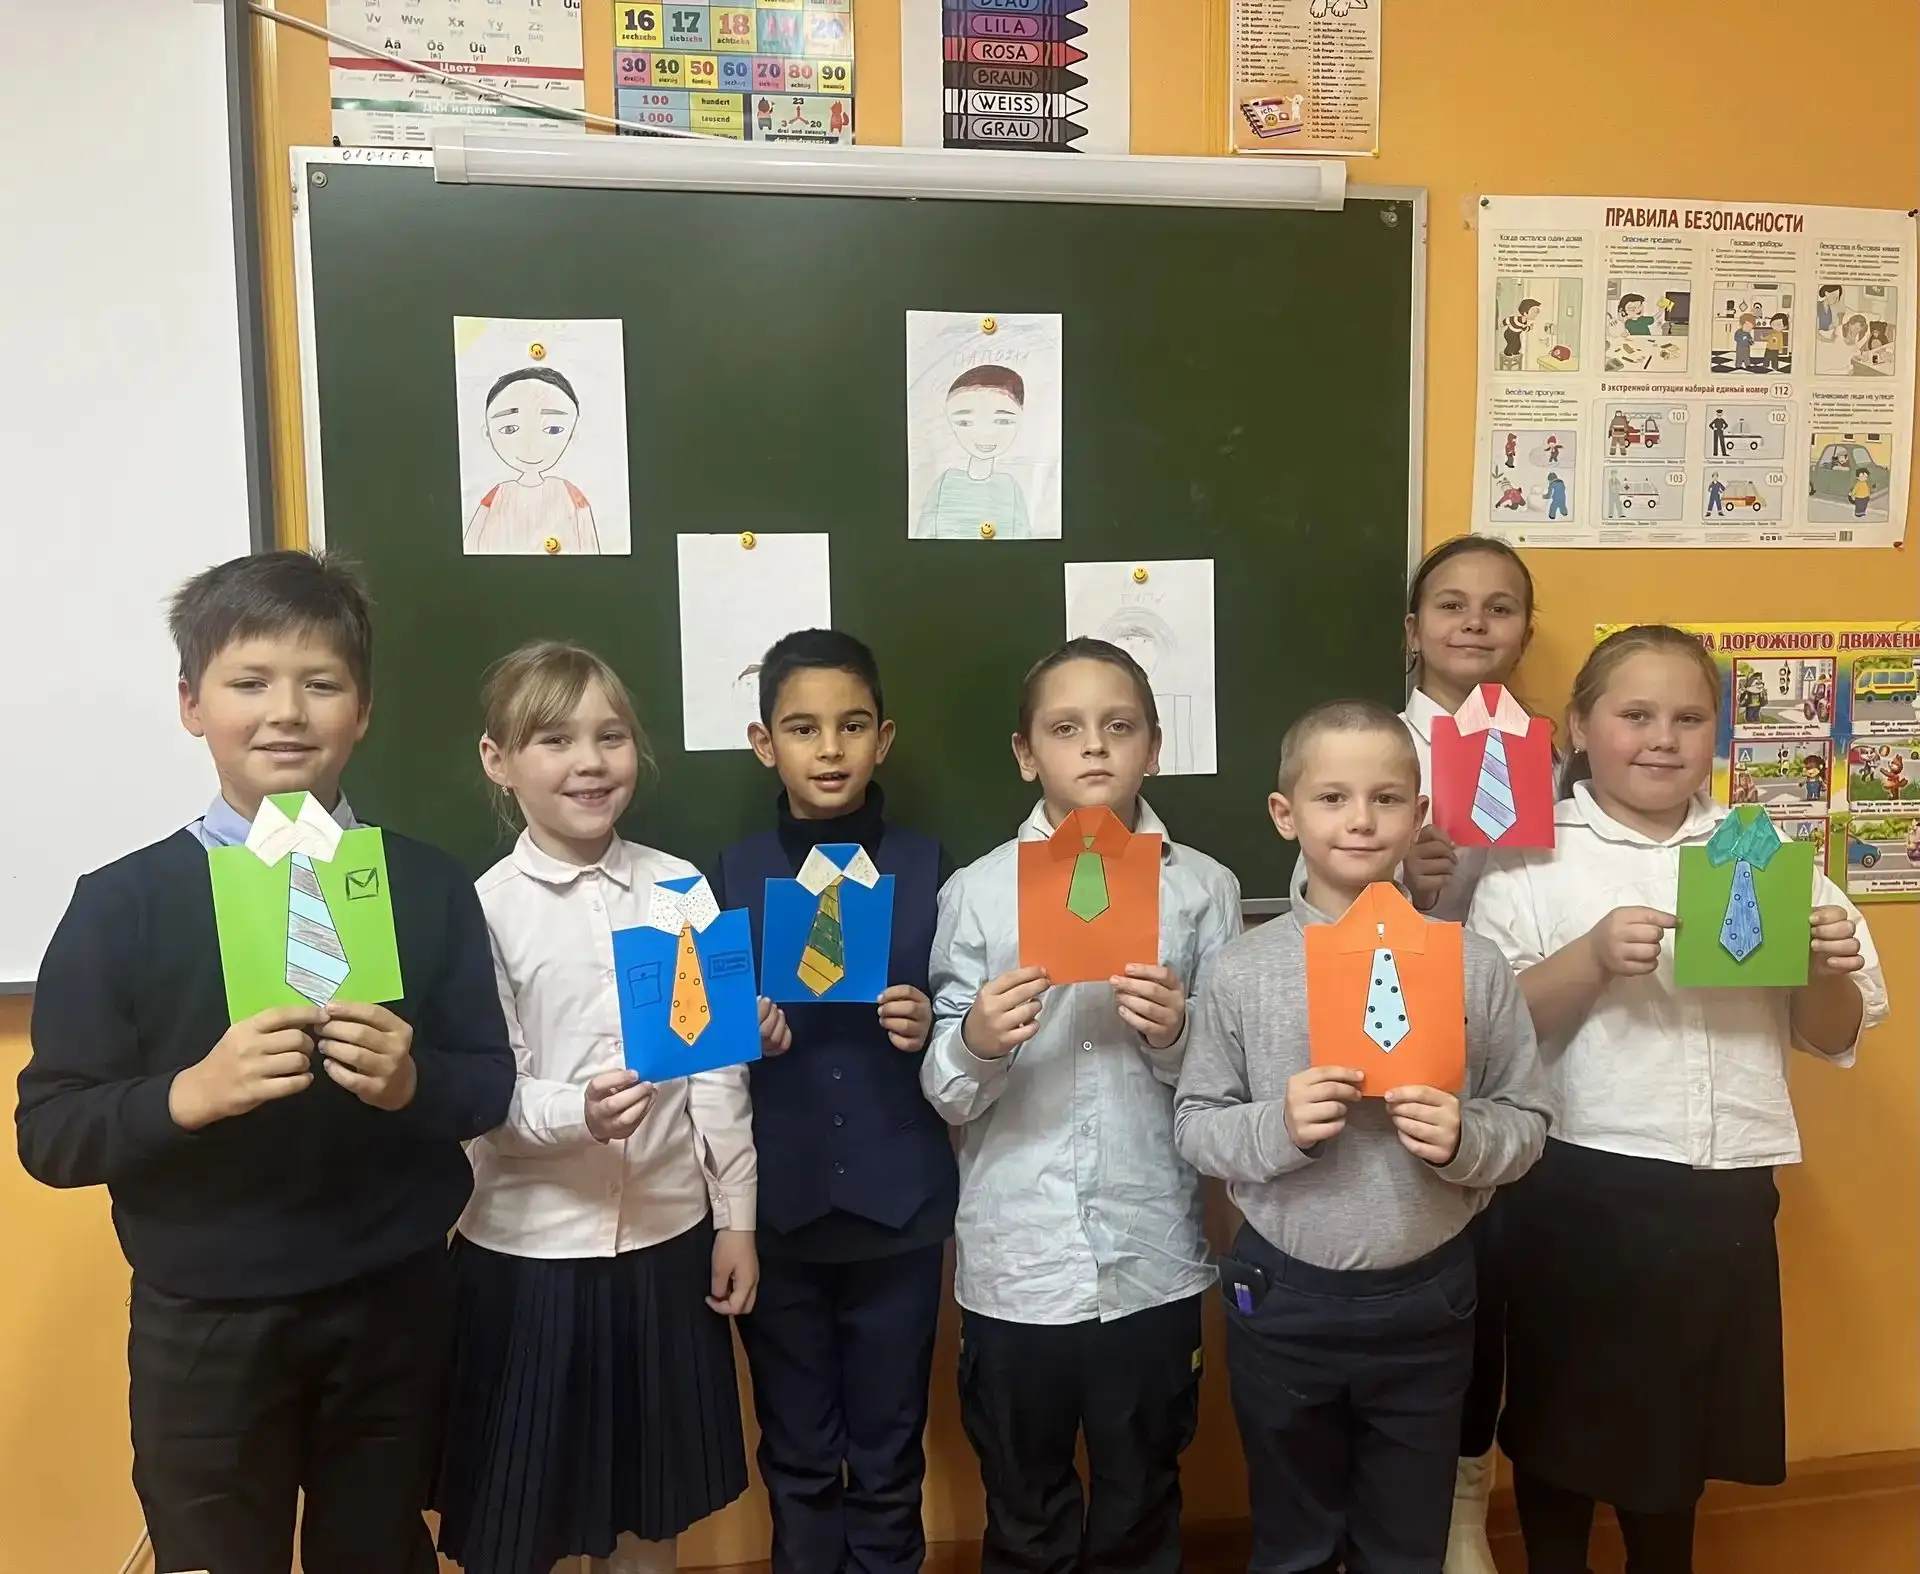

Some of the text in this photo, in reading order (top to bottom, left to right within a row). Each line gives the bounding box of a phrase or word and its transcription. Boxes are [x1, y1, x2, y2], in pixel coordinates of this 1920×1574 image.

[365, 12, 381, 23] Vv
[401, 14, 424, 25] Ww
[624, 8, 655, 31] 16
[672, 10, 701, 33] 17
[719, 13, 750, 36] 18
[984, 17, 1026, 34] LILA
[384, 37, 522, 55] Ää Öö Üü ß
[670, 35, 703, 43] siebzehn
[982, 43, 1028, 61] ROSA
[440, 62, 476, 73] Цвета
[622, 57, 646, 73] 30
[655, 59, 680, 74] 40
[690, 60, 714, 76] 50
[723, 62, 748, 77] 60
[757, 63, 780, 78] 70
[788, 64, 813, 79] 80
[822, 65, 846, 81] 90
[978, 69, 1033, 87] BRAUN
[642, 95, 669, 105] 100
[701, 97, 730, 106] hundert
[792, 97, 804, 105] 23
[978, 95, 1033, 112] WEISS
[701, 115, 731, 123] tausend
[810, 120, 822, 128] 20
[981, 121, 1030, 138] GRAU
[1605, 207, 1804, 233] ПРАВИЛА БЕЗОПАСНОСТИ
[1500, 234, 1518, 242] Когда
[1601, 383, 1606, 391] В
[1607, 384, 1650, 393] экстренной
[1685, 384, 1714, 393] набирай
[1716, 385, 1744, 393] единый
[1745, 386, 1768, 394] номер
[1774, 386, 1789, 395] 112
[1672, 412, 1685, 421] 101
[1772, 413, 1786, 422] 102
[1670, 474, 1683, 483] 103
[1769, 475, 1783, 483] 104
[1720, 633, 1833, 651] ДОРОЖНОГО
